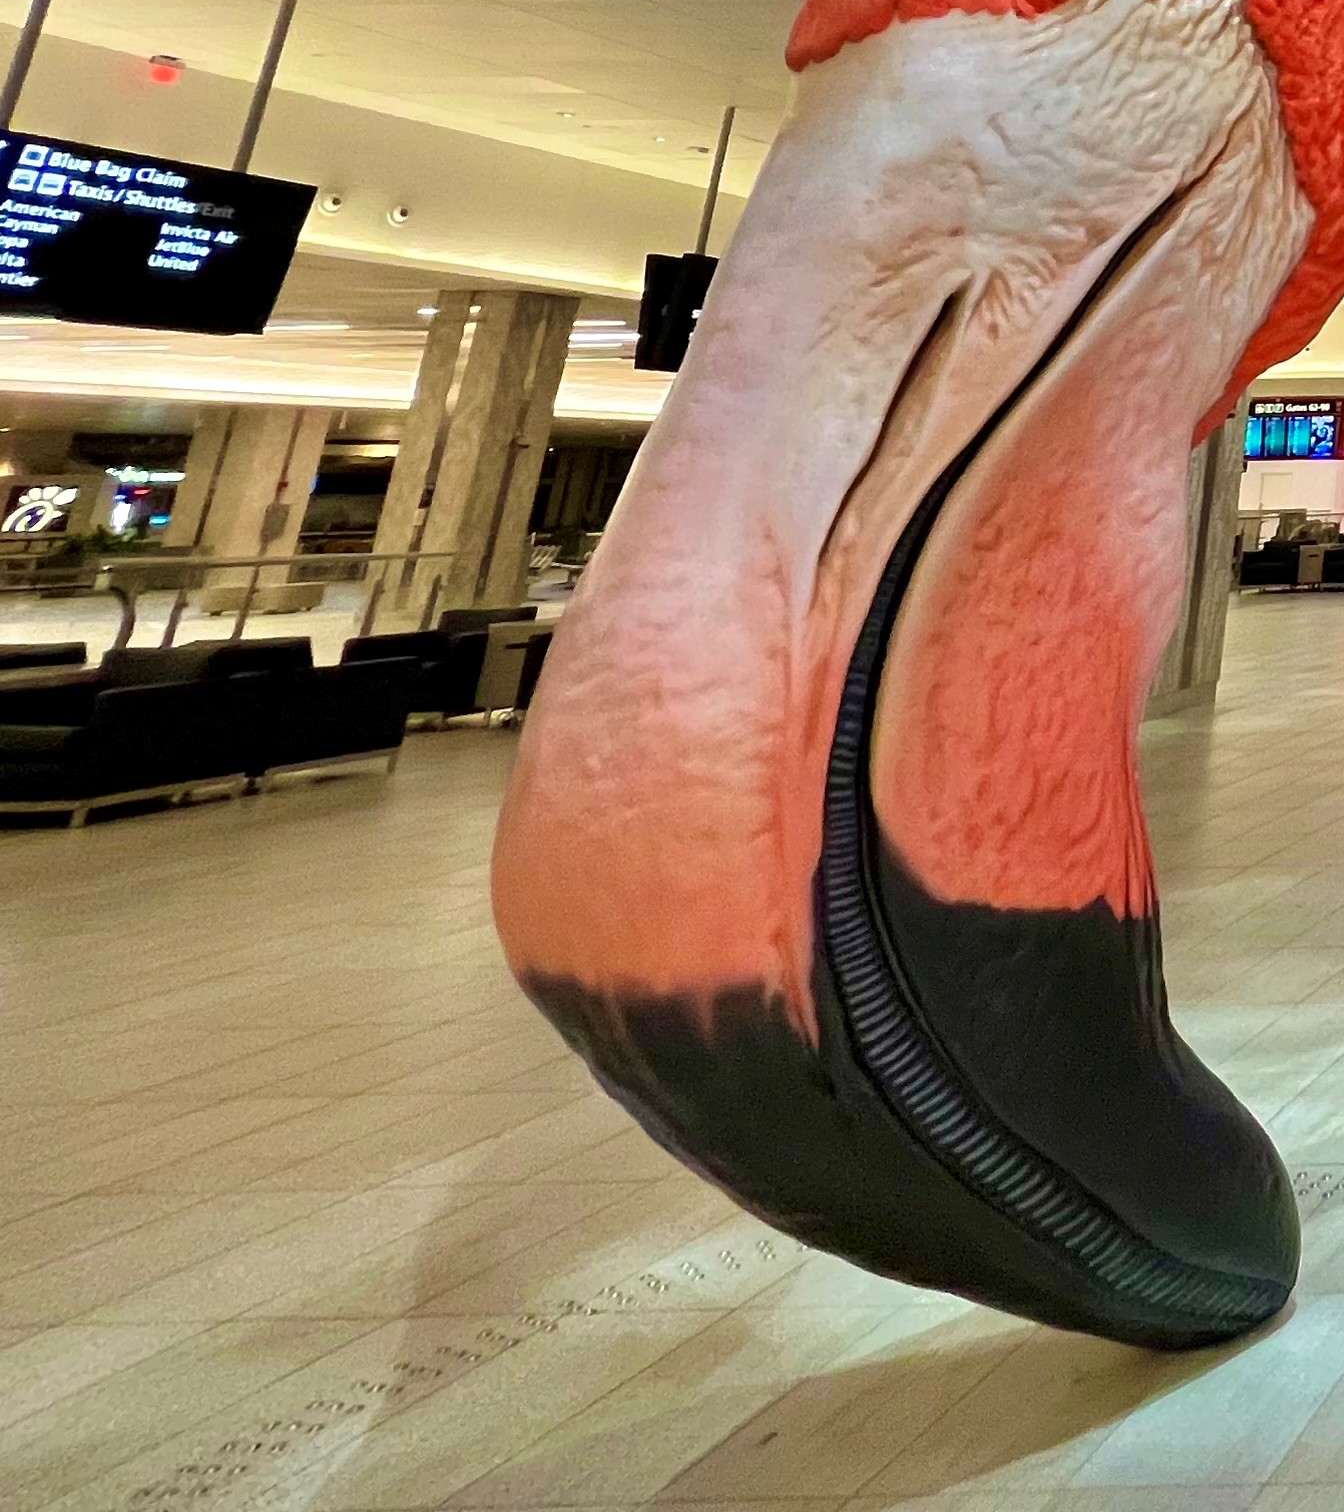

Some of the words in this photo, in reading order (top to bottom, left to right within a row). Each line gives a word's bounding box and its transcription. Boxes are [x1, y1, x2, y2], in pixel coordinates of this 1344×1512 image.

[48, 151, 92, 172] Blue
[95, 160, 132, 182] Bag
[136, 168, 189, 188] Claim
[69, 180, 114, 202] Taxis
[124, 190, 196, 214] Shuttles
[0, 199, 82, 222] American
[213, 231, 239, 245] Air
[147, 254, 199, 272] United
